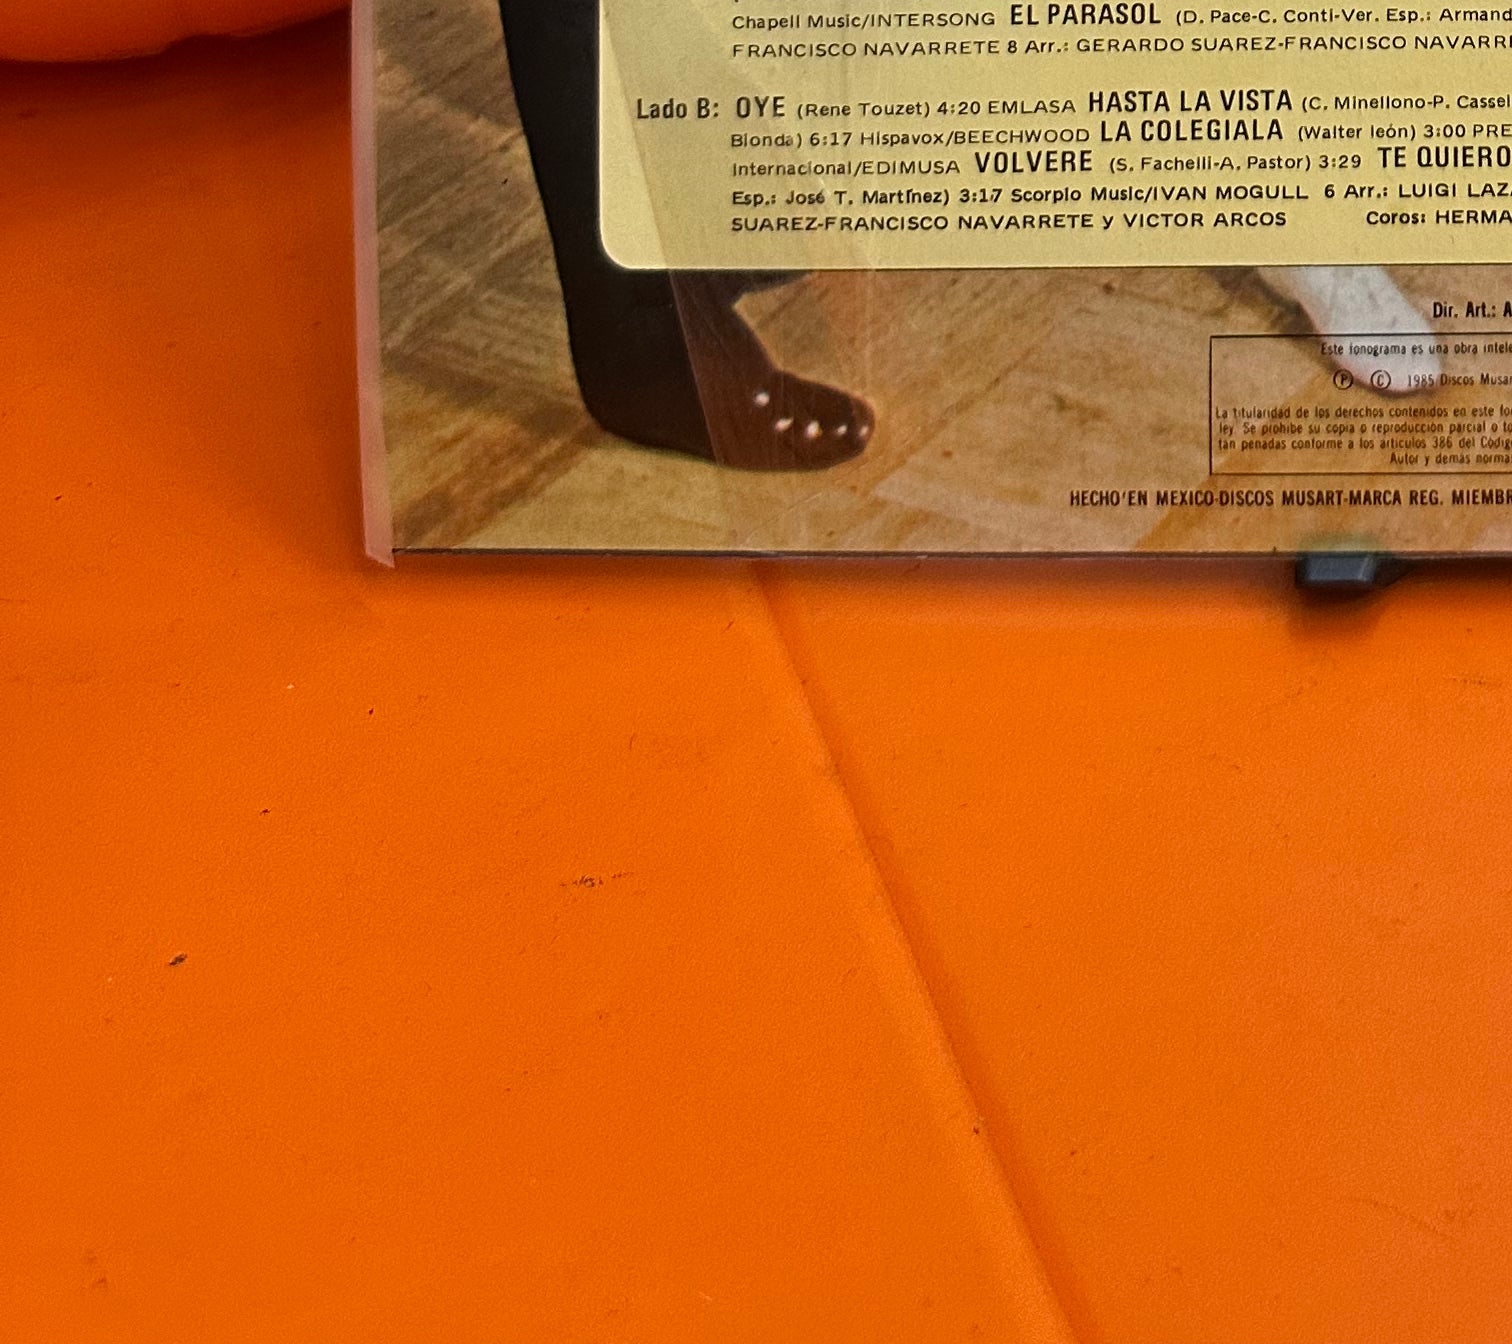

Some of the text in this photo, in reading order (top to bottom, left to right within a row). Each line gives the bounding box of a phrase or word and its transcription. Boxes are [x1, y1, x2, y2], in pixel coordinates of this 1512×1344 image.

[1010, 2, 1162, 26] EL PARASOL
[732, 42, 857, 59] FRANCISCO
[863, 39, 1000, 57] NAVARRETE
[1007, 39, 1018, 55] 8
[1024, 39, 1069, 55] Arr.:
[1076, 37, 1185, 53] GERARDO
[1191, 35, 1407, 53] SUAREZ-FRANCISCO
[636, 95, 786, 120] Lado B: OYE
[1088, 88, 1293, 114] HASTA LA VISTA
[1100, 118, 1284, 144] LA COLEGIALA
[974, 149, 1093, 174] VOLVERE
[1376, 145, 1407, 170] TE
[1416, 144, 1512, 171] QUIERO
[730, 211, 1287, 233] SUAREZ-FRANCISCO NAVARRETE y VICTOR ARCOS
[1365, 210, 1426, 226] Coros:
[1433, 301, 1458, 320] Dir.
[1409, 489, 1443, 506] REG.
